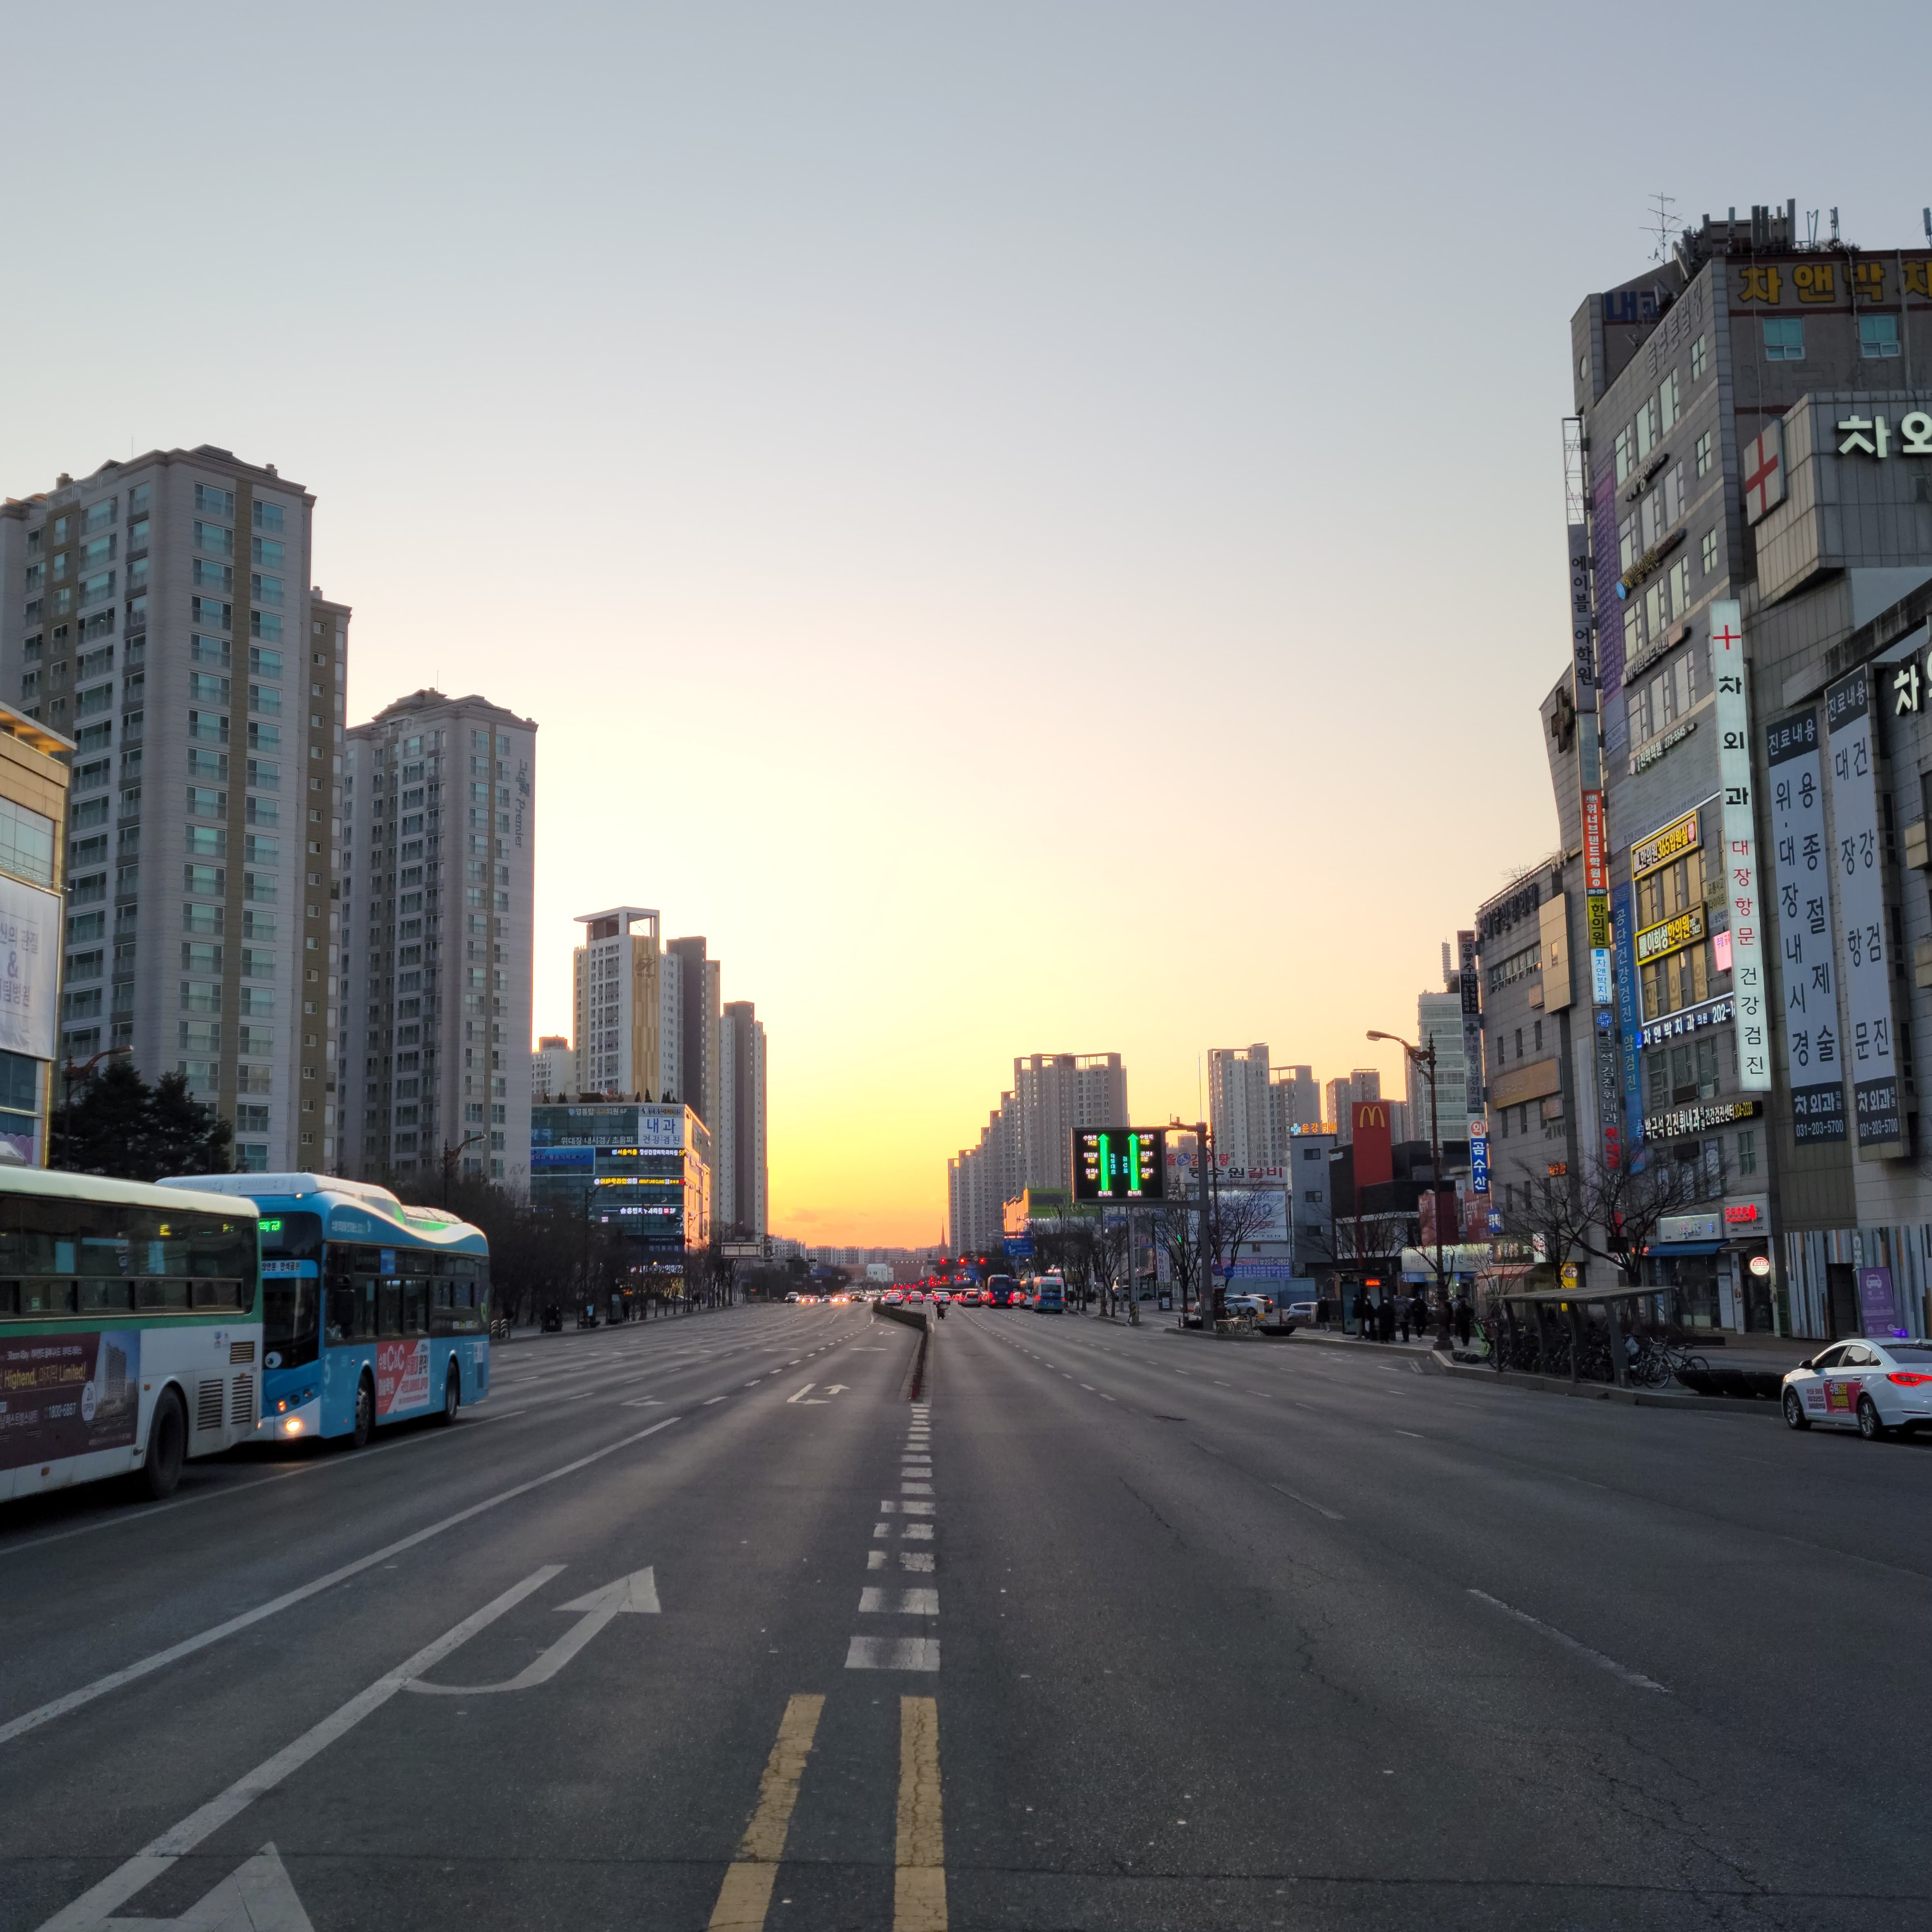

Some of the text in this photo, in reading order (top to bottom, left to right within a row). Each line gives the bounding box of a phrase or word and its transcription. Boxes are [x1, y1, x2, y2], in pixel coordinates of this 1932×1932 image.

[1571, 555, 1593, 686] 에이블 어학원
[1828, 680, 1865, 722] 진료내용
[1894, 650, 1932, 716] 차
[1719, 676, 1748, 804] 차외과
[1769, 718, 1816, 756] 진료내용
[515, 798, 526, 848] Premier
[1587, 804, 1601, 878] 위너브랜드학원
[1640, 842, 1658, 868] 한의원
[1732, 840, 1755, 945] 대장항문
[1835, 747, 1869, 1061] 대장항문
[1853, 737, 1889, 1056] 건강검진
[1591, 904, 1605, 946] 한의원
[1647, 925, 1668, 953] 이희성
[1667, 915, 1690, 945] 한의원
[1798, 772, 1835, 1062] 용종절제술
[1596, 959, 1608, 1003] 차앤박치과
[1643, 1001, 1735, 1045] 차앤박치과 의원 202-1
[1741, 967, 1764, 1074] 건강검진
[1624, 1036, 1637, 1092] 암검진
[1645, 1115, 1665, 1140] 박근석
[1705, 1103, 1735, 1125] 건강검진센터
[1734, 1101, 1753, 1119] 204-0033
[1795, 1089, 1835, 1114] 차외과
[1858, 1087, 1890, 1113] 차외과
[643, 1135, 680, 1144] 건강검진
[647, 1118, 676, 1134] 내과
[1796, 1120, 1844, 1137] 031-203-5700
[1860, 1119, 1898, 1137] 031-203-5700
[1473, 1141, 1487, 1191] 곰수산
[4, 1368, 37, 1390] Highend,
